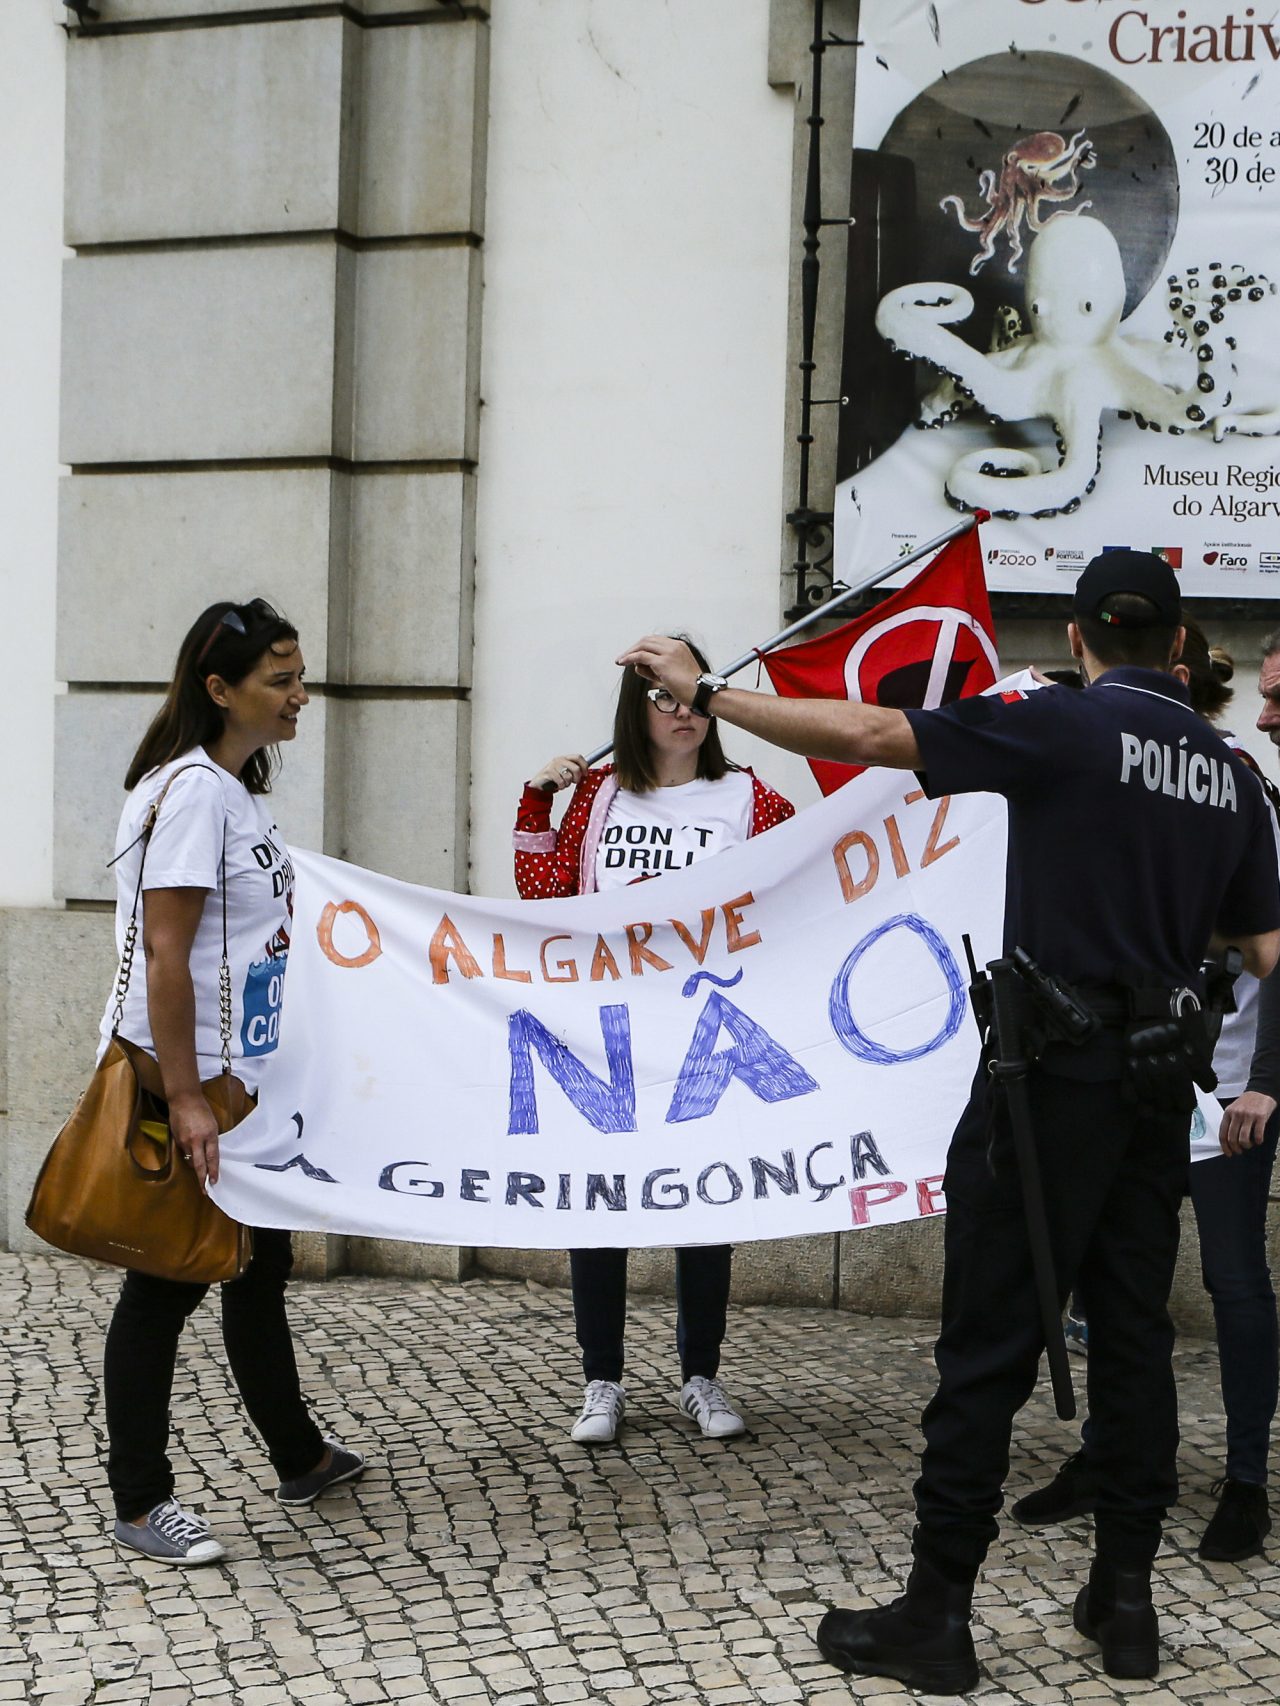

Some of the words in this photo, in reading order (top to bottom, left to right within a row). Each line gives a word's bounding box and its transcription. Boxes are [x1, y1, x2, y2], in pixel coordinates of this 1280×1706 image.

[1193, 122, 1225, 150] 20
[1233, 125, 1263, 148] de
[1205, 157, 1238, 184] 30
[1246, 160, 1275, 184] de
[1143, 464, 1218, 486] Museu
[1173, 495, 1202, 516] do
[1000, 555, 1037, 566] 2020
[1219, 553, 1248, 566] Faro
[1120, 732, 1238, 813] POLÍCIA
[316, 900, 383, 968] O
[429, 890, 762, 984] ALGARVE
[832, 788, 961, 905] DIZ
[507, 912, 970, 1136] NÃO
[378, 1129, 893, 1212] GERINGONÇA
